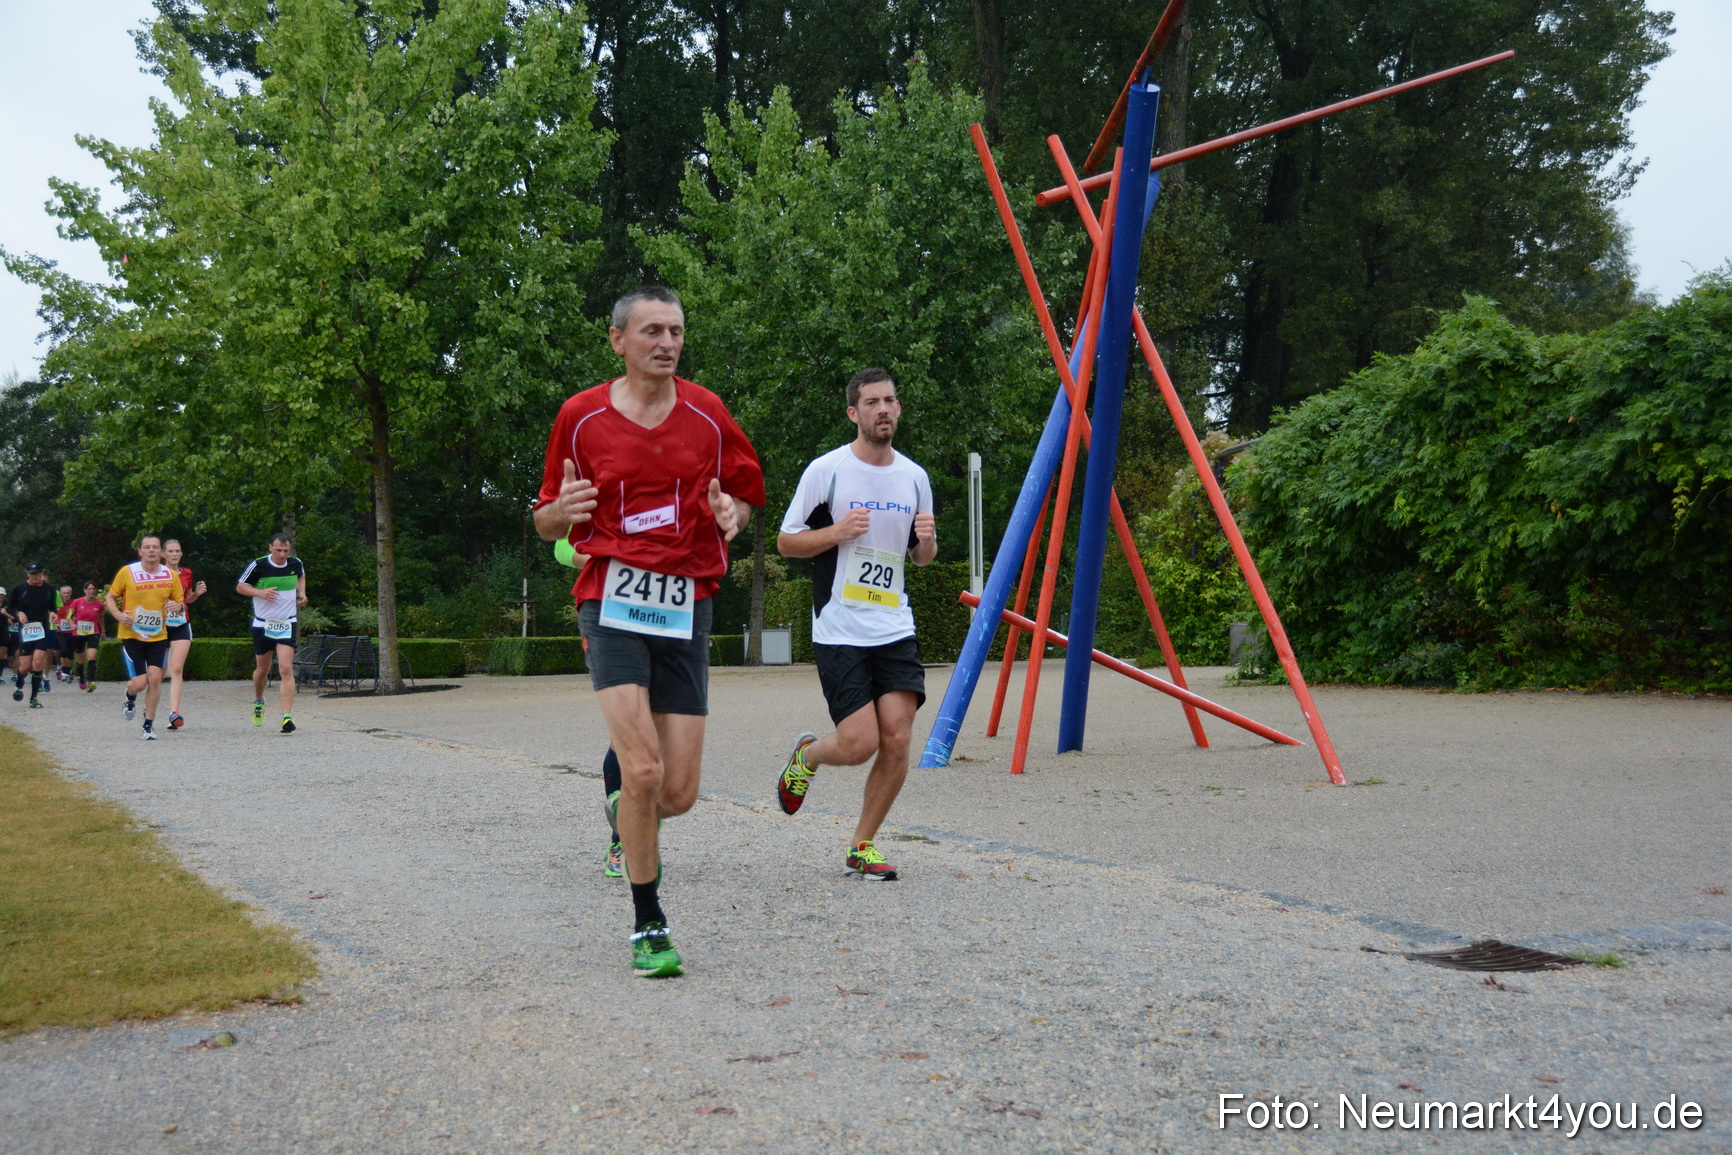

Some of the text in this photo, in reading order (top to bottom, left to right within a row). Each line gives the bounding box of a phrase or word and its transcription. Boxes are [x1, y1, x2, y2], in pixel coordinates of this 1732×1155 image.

[849, 501, 911, 515] DELPHI
[638, 514, 662, 527] DEHN
[858, 561, 894, 589] 229
[614, 567, 687, 607] 2413
[867, 590, 882, 602] Tim
[136, 614, 161, 626] 2728
[628, 608, 667, 625] Martin
[23, 626, 43, 635] 2705
